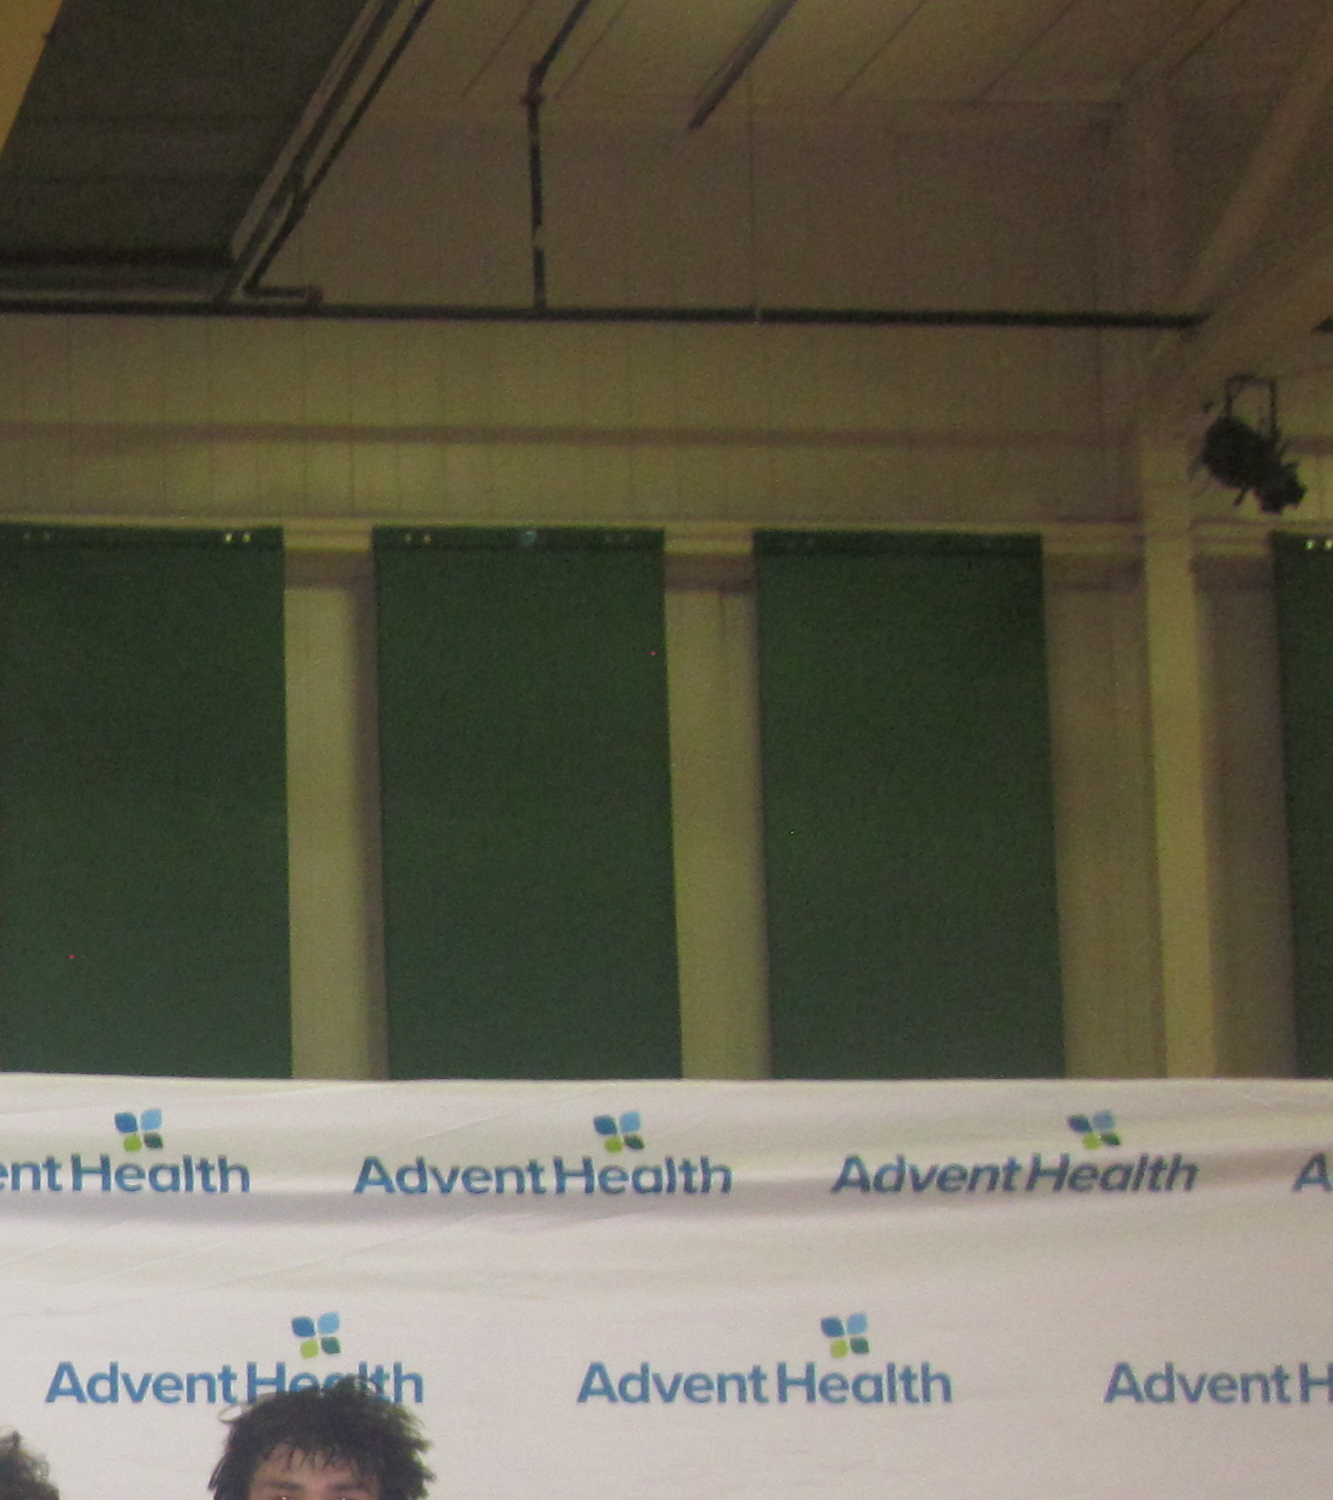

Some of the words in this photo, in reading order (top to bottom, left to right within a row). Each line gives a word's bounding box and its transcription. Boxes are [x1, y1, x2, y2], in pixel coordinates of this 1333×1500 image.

[349, 1153, 734, 1200] AdventHealth
[829, 1152, 1200, 1197] AdventHealth
[574, 1360, 954, 1406] AdventHealth
[1102, 1360, 1333, 1404] AdventH
